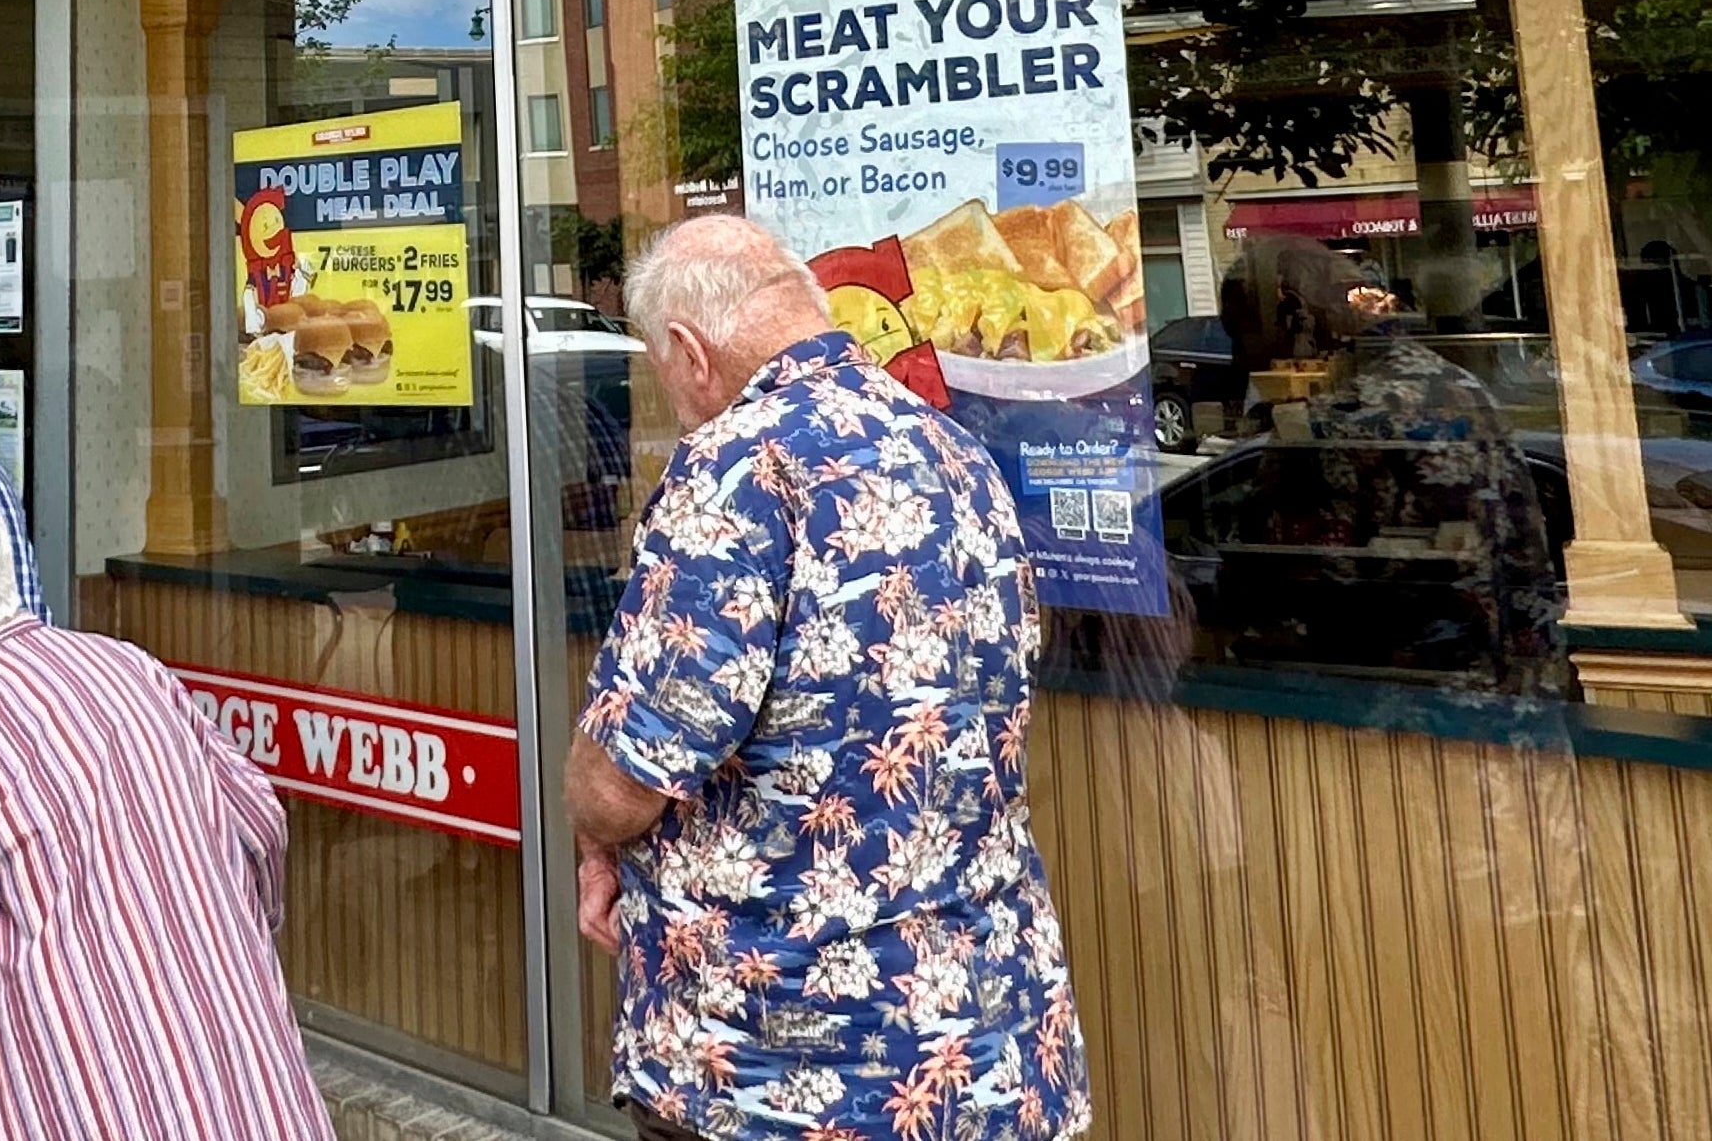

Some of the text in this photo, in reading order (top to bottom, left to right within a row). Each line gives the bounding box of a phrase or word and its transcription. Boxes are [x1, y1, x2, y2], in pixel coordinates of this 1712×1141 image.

[748, 2, 898, 65] MEAT
[749, 42, 1104, 119] SCRAMBLER
[753, 123, 985, 160] Choose Sausage,
[260, 152, 459, 196] DOUBLE PLAY
[755, 171, 817, 202] Ham,
[822, 176, 851, 195] or
[860, 164, 946, 194] Bacon
[1002, 158, 1078, 187] $9.99
[316, 191, 445, 223] MEAL DEAL
[318, 245, 459, 272] 7 CHEESE BURGERS 2 FRIES
[382, 278, 453, 313] $17.99
[1019, 439, 1119, 458] Ready to Order?
[292, 709, 450, 802] WEBB
